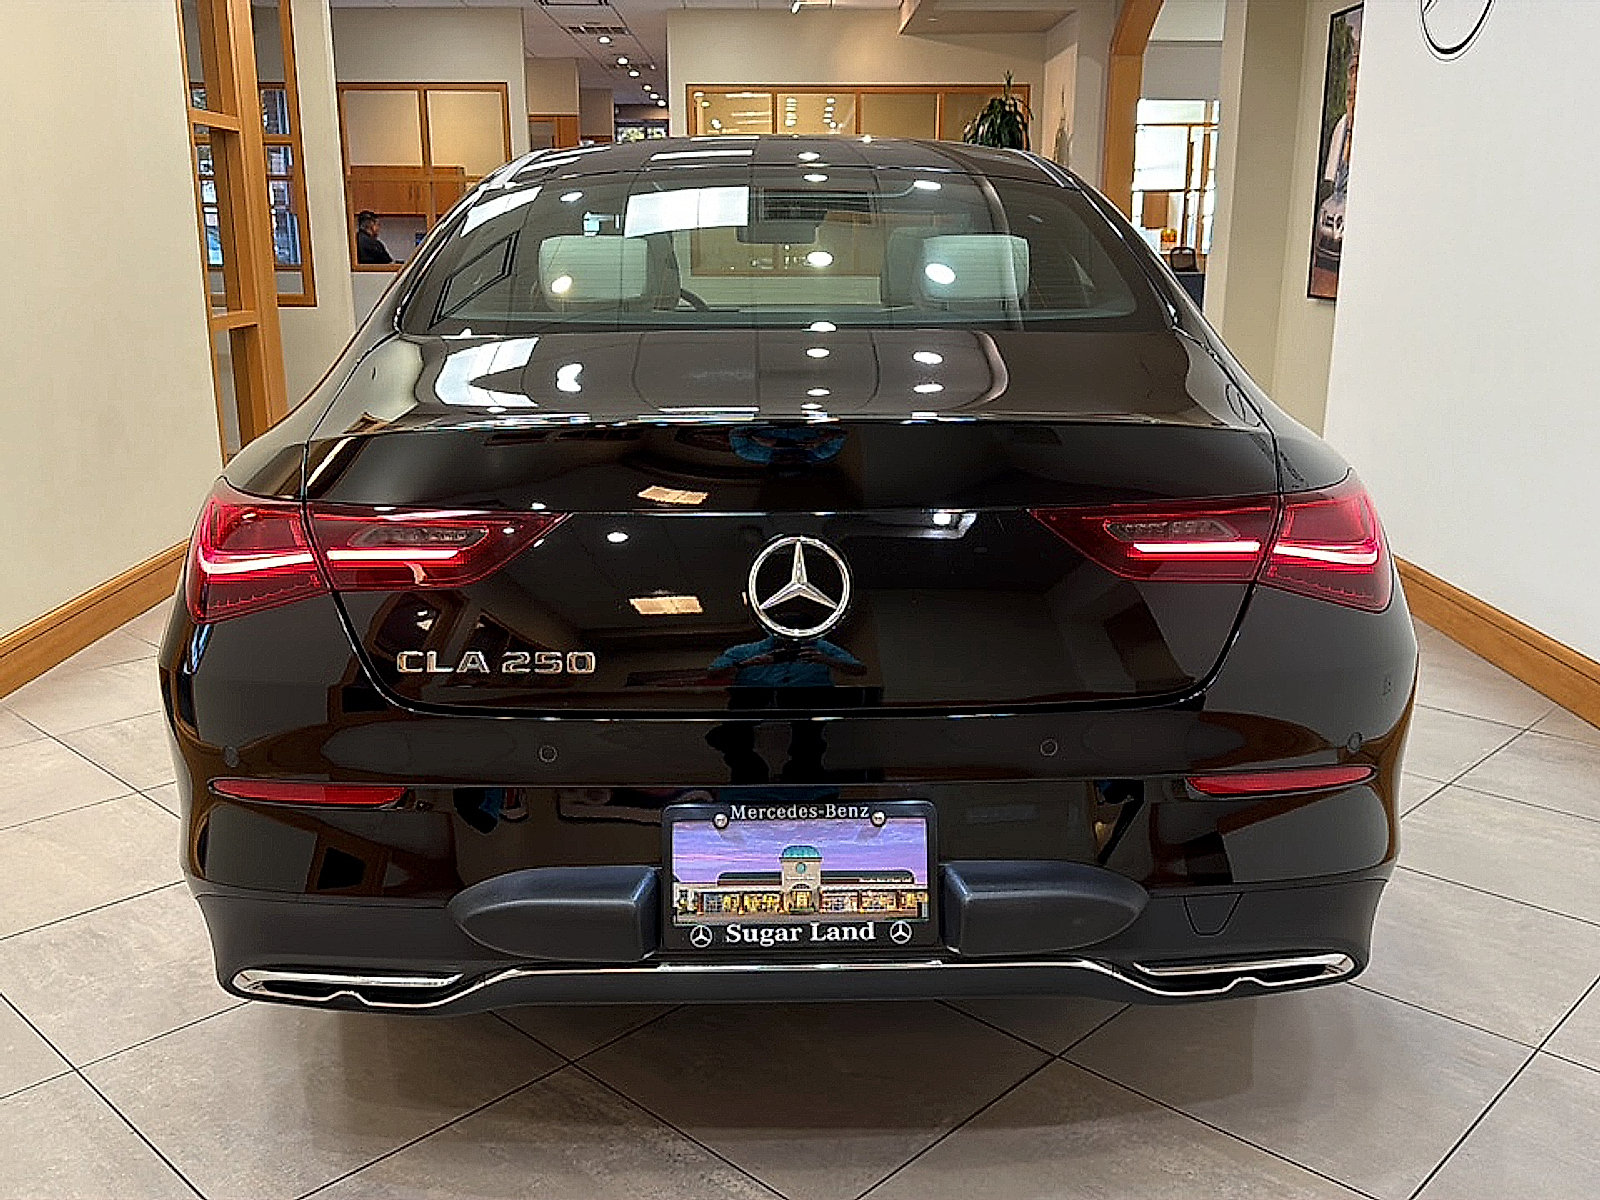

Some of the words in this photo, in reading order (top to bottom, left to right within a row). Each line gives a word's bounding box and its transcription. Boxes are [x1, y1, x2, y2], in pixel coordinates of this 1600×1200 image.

[396, 650, 490, 673] CLA
[501, 651, 596, 674] 250
[730, 804, 870, 820] Mercedes-Benz
[725, 923, 803, 946] Sugar
[810, 922, 876, 941] Land
